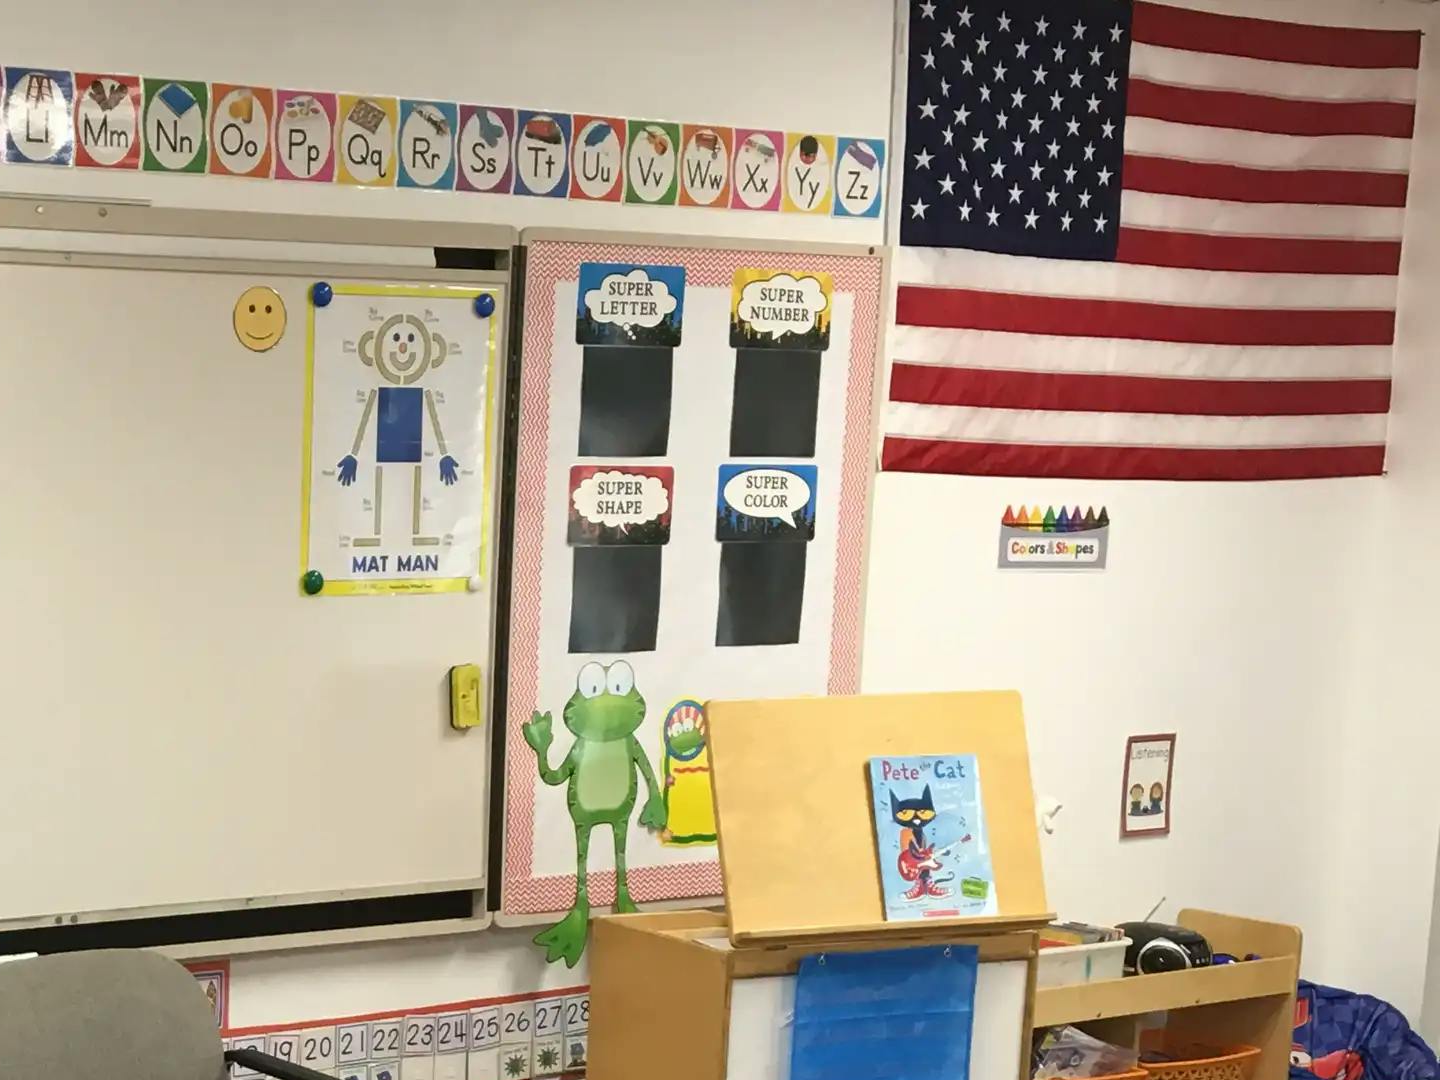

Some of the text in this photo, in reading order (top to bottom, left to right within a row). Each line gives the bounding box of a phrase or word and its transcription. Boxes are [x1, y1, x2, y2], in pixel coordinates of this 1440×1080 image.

[83, 112, 129, 149] Mm
[155, 118, 193, 154] Nn
[220, 123, 258, 158] Oo
[288, 128, 320, 175] Pp
[347, 134, 386, 178] Qq
[411, 137, 441, 169] Rr
[470, 142, 497, 174] Ss
[527, 146, 556, 178] Tt
[582, 151, 611, 183] Uu
[638, 156, 664, 187] Vv
[686, 158, 723, 190] Ww
[742, 163, 769, 194] Xx
[795, 166, 820, 208] Yy
[845, 170, 869, 200] Zz
[608, 280, 654, 297] SUPER
[760, 287, 804, 304] SUPER
[600, 301, 658, 317] LETTER
[750, 306, 810, 322] NUMBER
[597, 481, 643, 496] SUPER
[746, 476, 788, 490] SUPER
[596, 500, 642, 515] SHAPE
[744, 494, 788, 508] COLOR
[352, 554, 439, 573] MAT MAN
[882, 760, 920, 781] Pete
[934, 760, 966, 779] Cat
[274, 1041, 293, 1063] 19
[305, 1037, 332, 1060] 20
[341, 1032, 365, 1055] 21
[373, 1028, 399, 1050] 22
[407, 1024, 433, 1046] 23
[438, 1019, 466, 1044] 24
[473, 1016, 498, 1041] 25
[505, 1011, 530, 1033] 26
[536, 1006, 561, 1030] 27
[567, 1001, 589, 1025] 28
